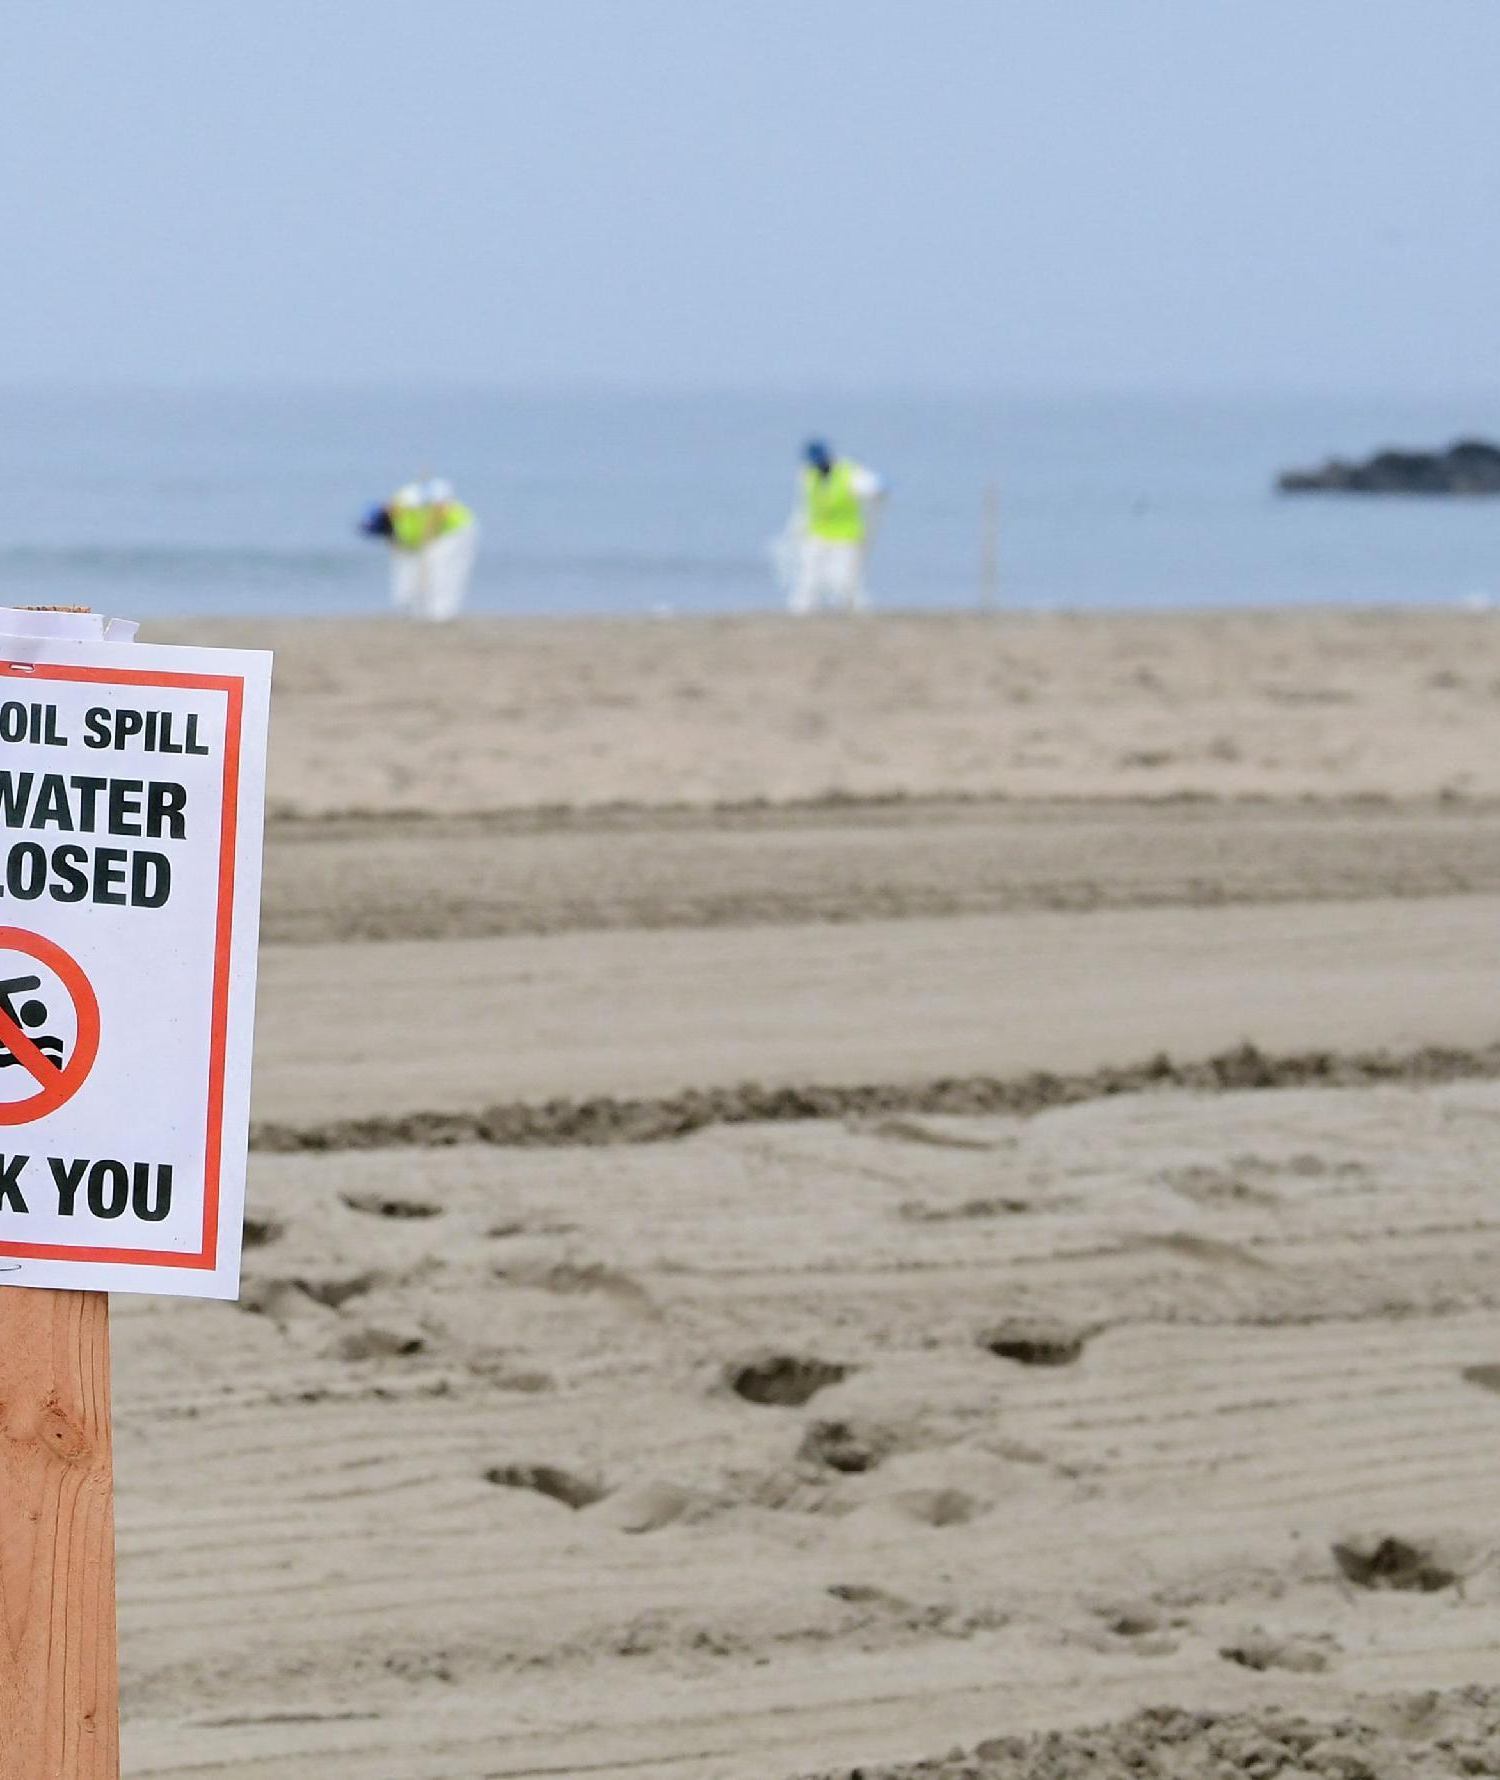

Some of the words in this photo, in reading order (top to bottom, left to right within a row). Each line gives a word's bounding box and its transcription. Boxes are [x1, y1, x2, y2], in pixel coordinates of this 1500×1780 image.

[0, 702, 67, 746] OIL
[84, 708, 208, 755] SPILL
[47, 1157, 172, 1221] YOU
